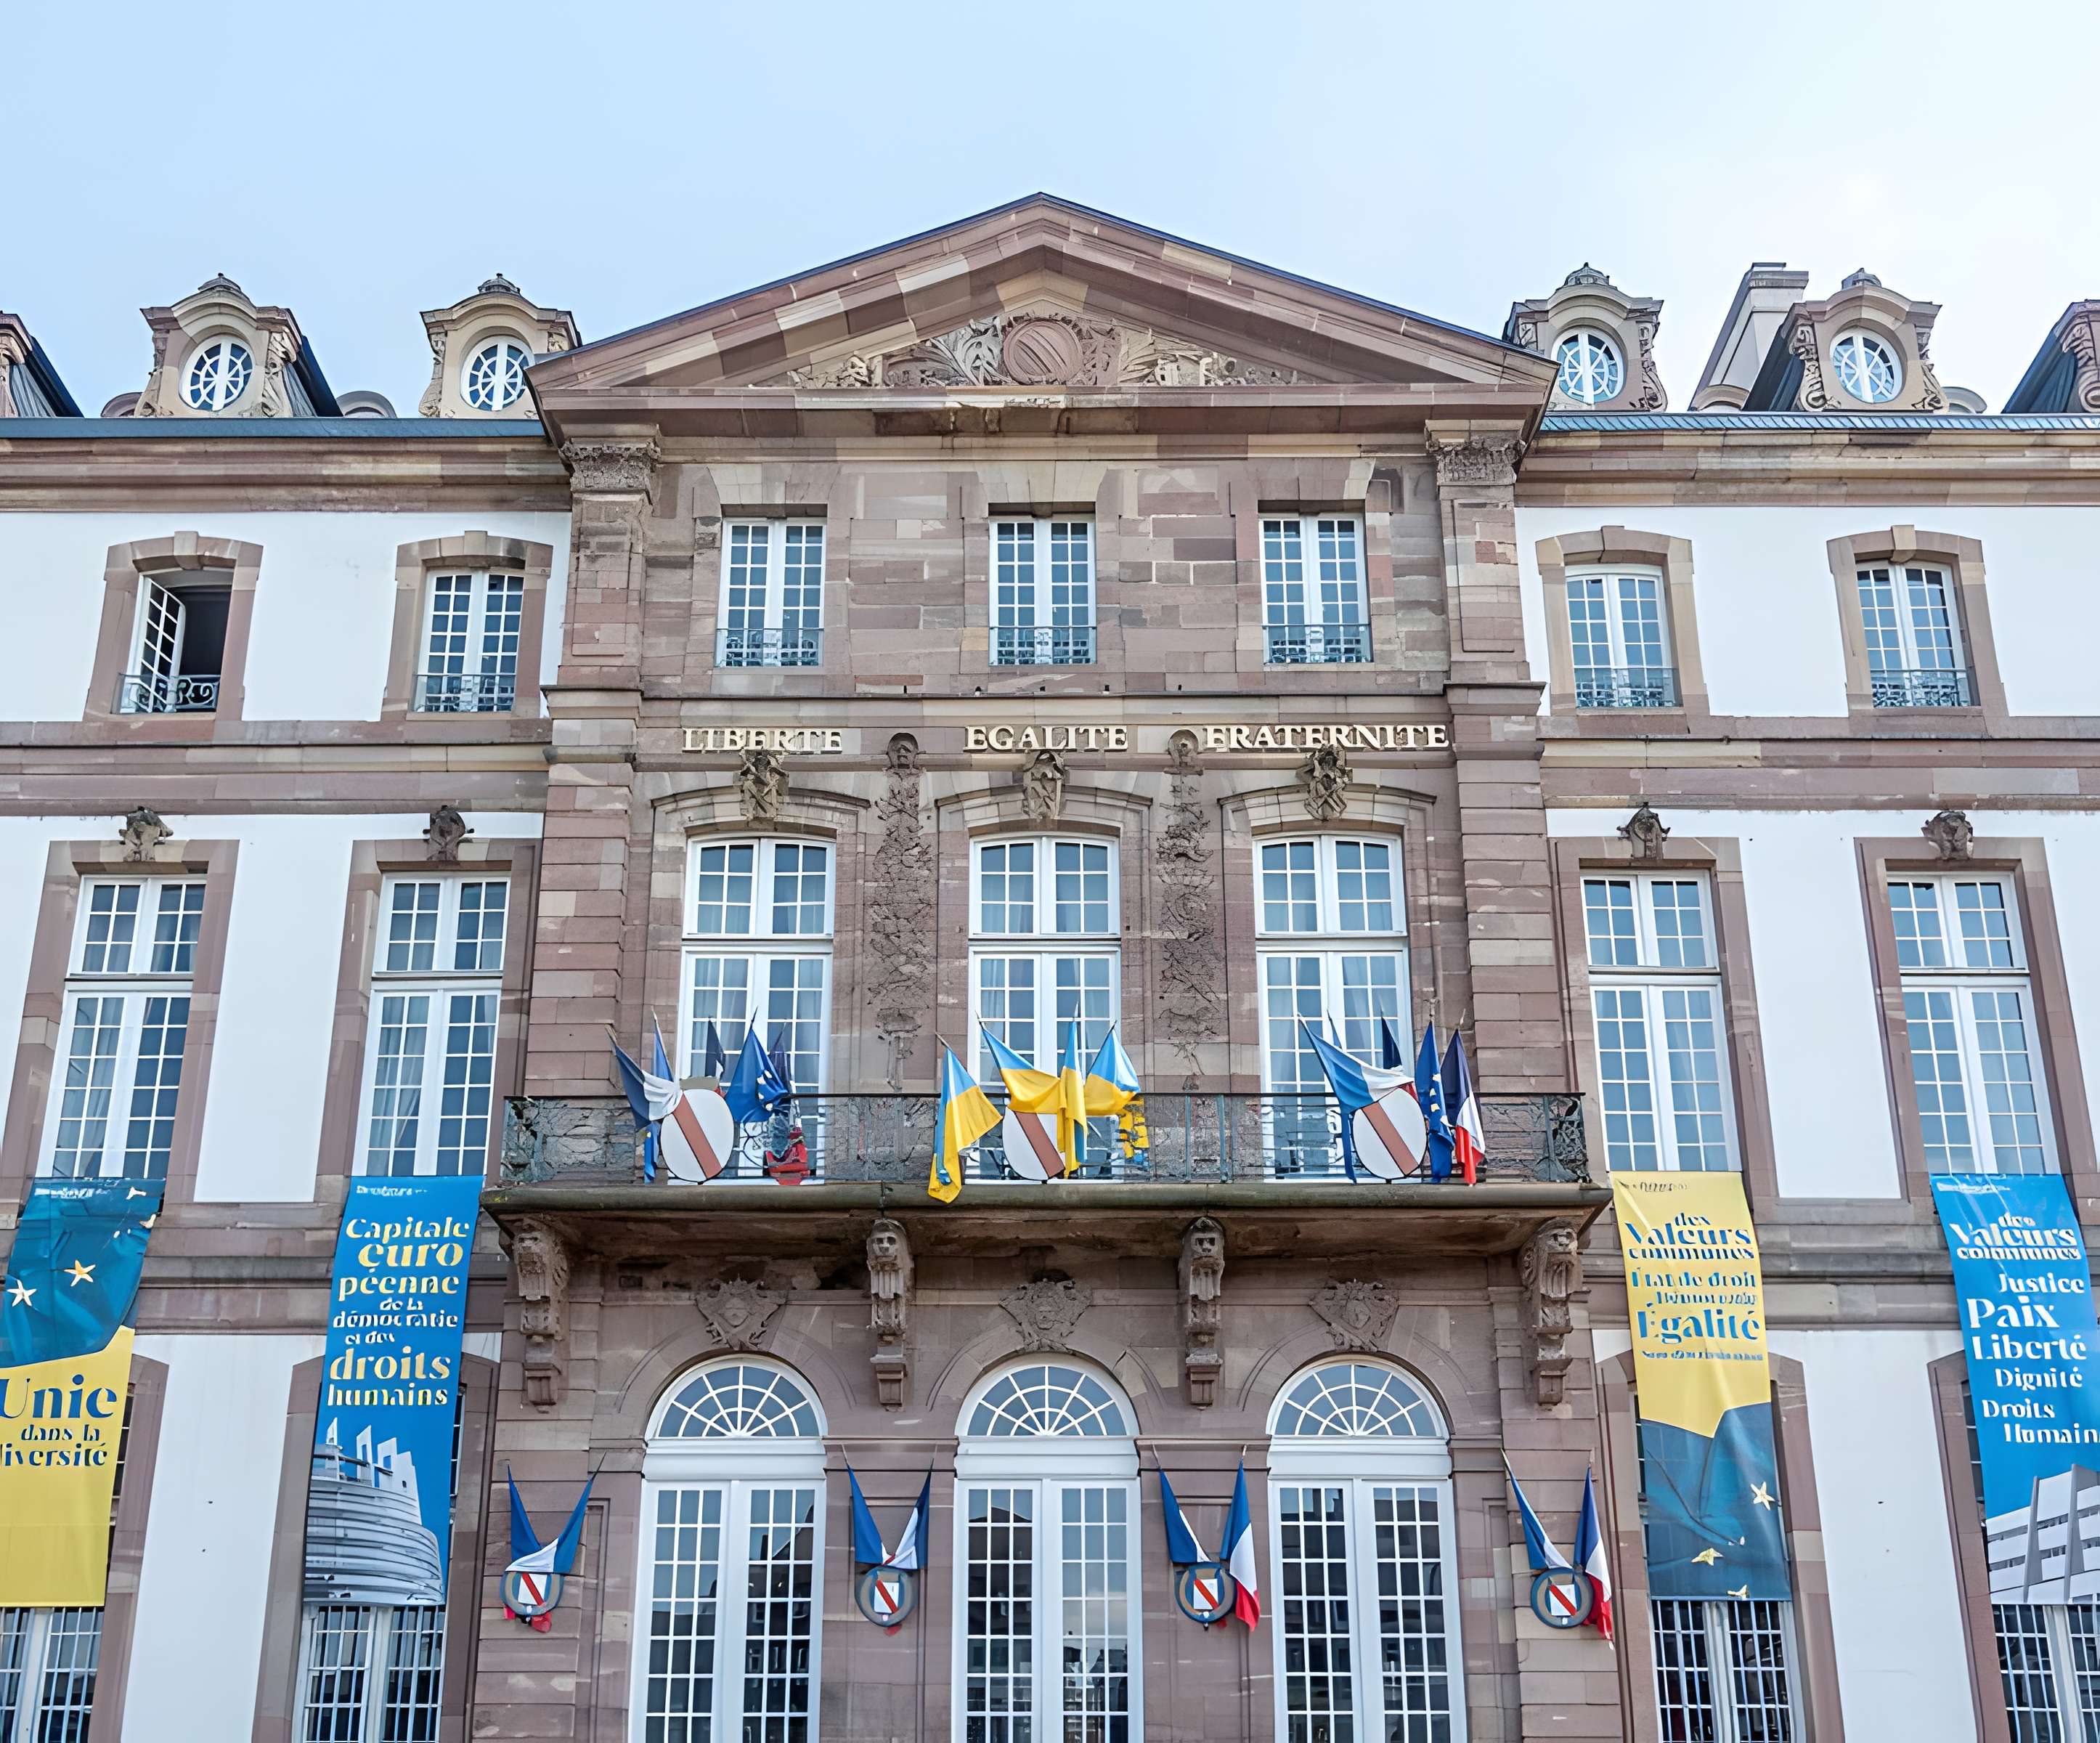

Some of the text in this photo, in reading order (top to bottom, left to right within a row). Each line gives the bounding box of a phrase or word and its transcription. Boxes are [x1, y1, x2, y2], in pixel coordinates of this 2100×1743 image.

[682, 724, 1449, 752] LIBERTE EGALITE FRATERNITE
[346, 1216, 470, 1244] Capitale
[1624, 1222, 1752, 1246] Valeurs
[1949, 1222, 2078, 1247] Valeurs
[358, 1243, 464, 1267] euro
[1999, 1272, 2085, 1293] Justice
[1966, 1295, 2061, 1329] Paix
[1971, 1333, 2088, 1360] Liberté
[329, 1345, 452, 1380] droits
[1995, 1366, 2084, 1391] Dignité
[0, 1373, 118, 1419] Unie
[327, 1382, 449, 1407] humains
[1981, 1397, 2056, 1418] Droits
[20, 1423, 73, 1442] dans
[2003, 1422, 2100, 1444] Humain
[0, 1442, 108, 1467] iversité
